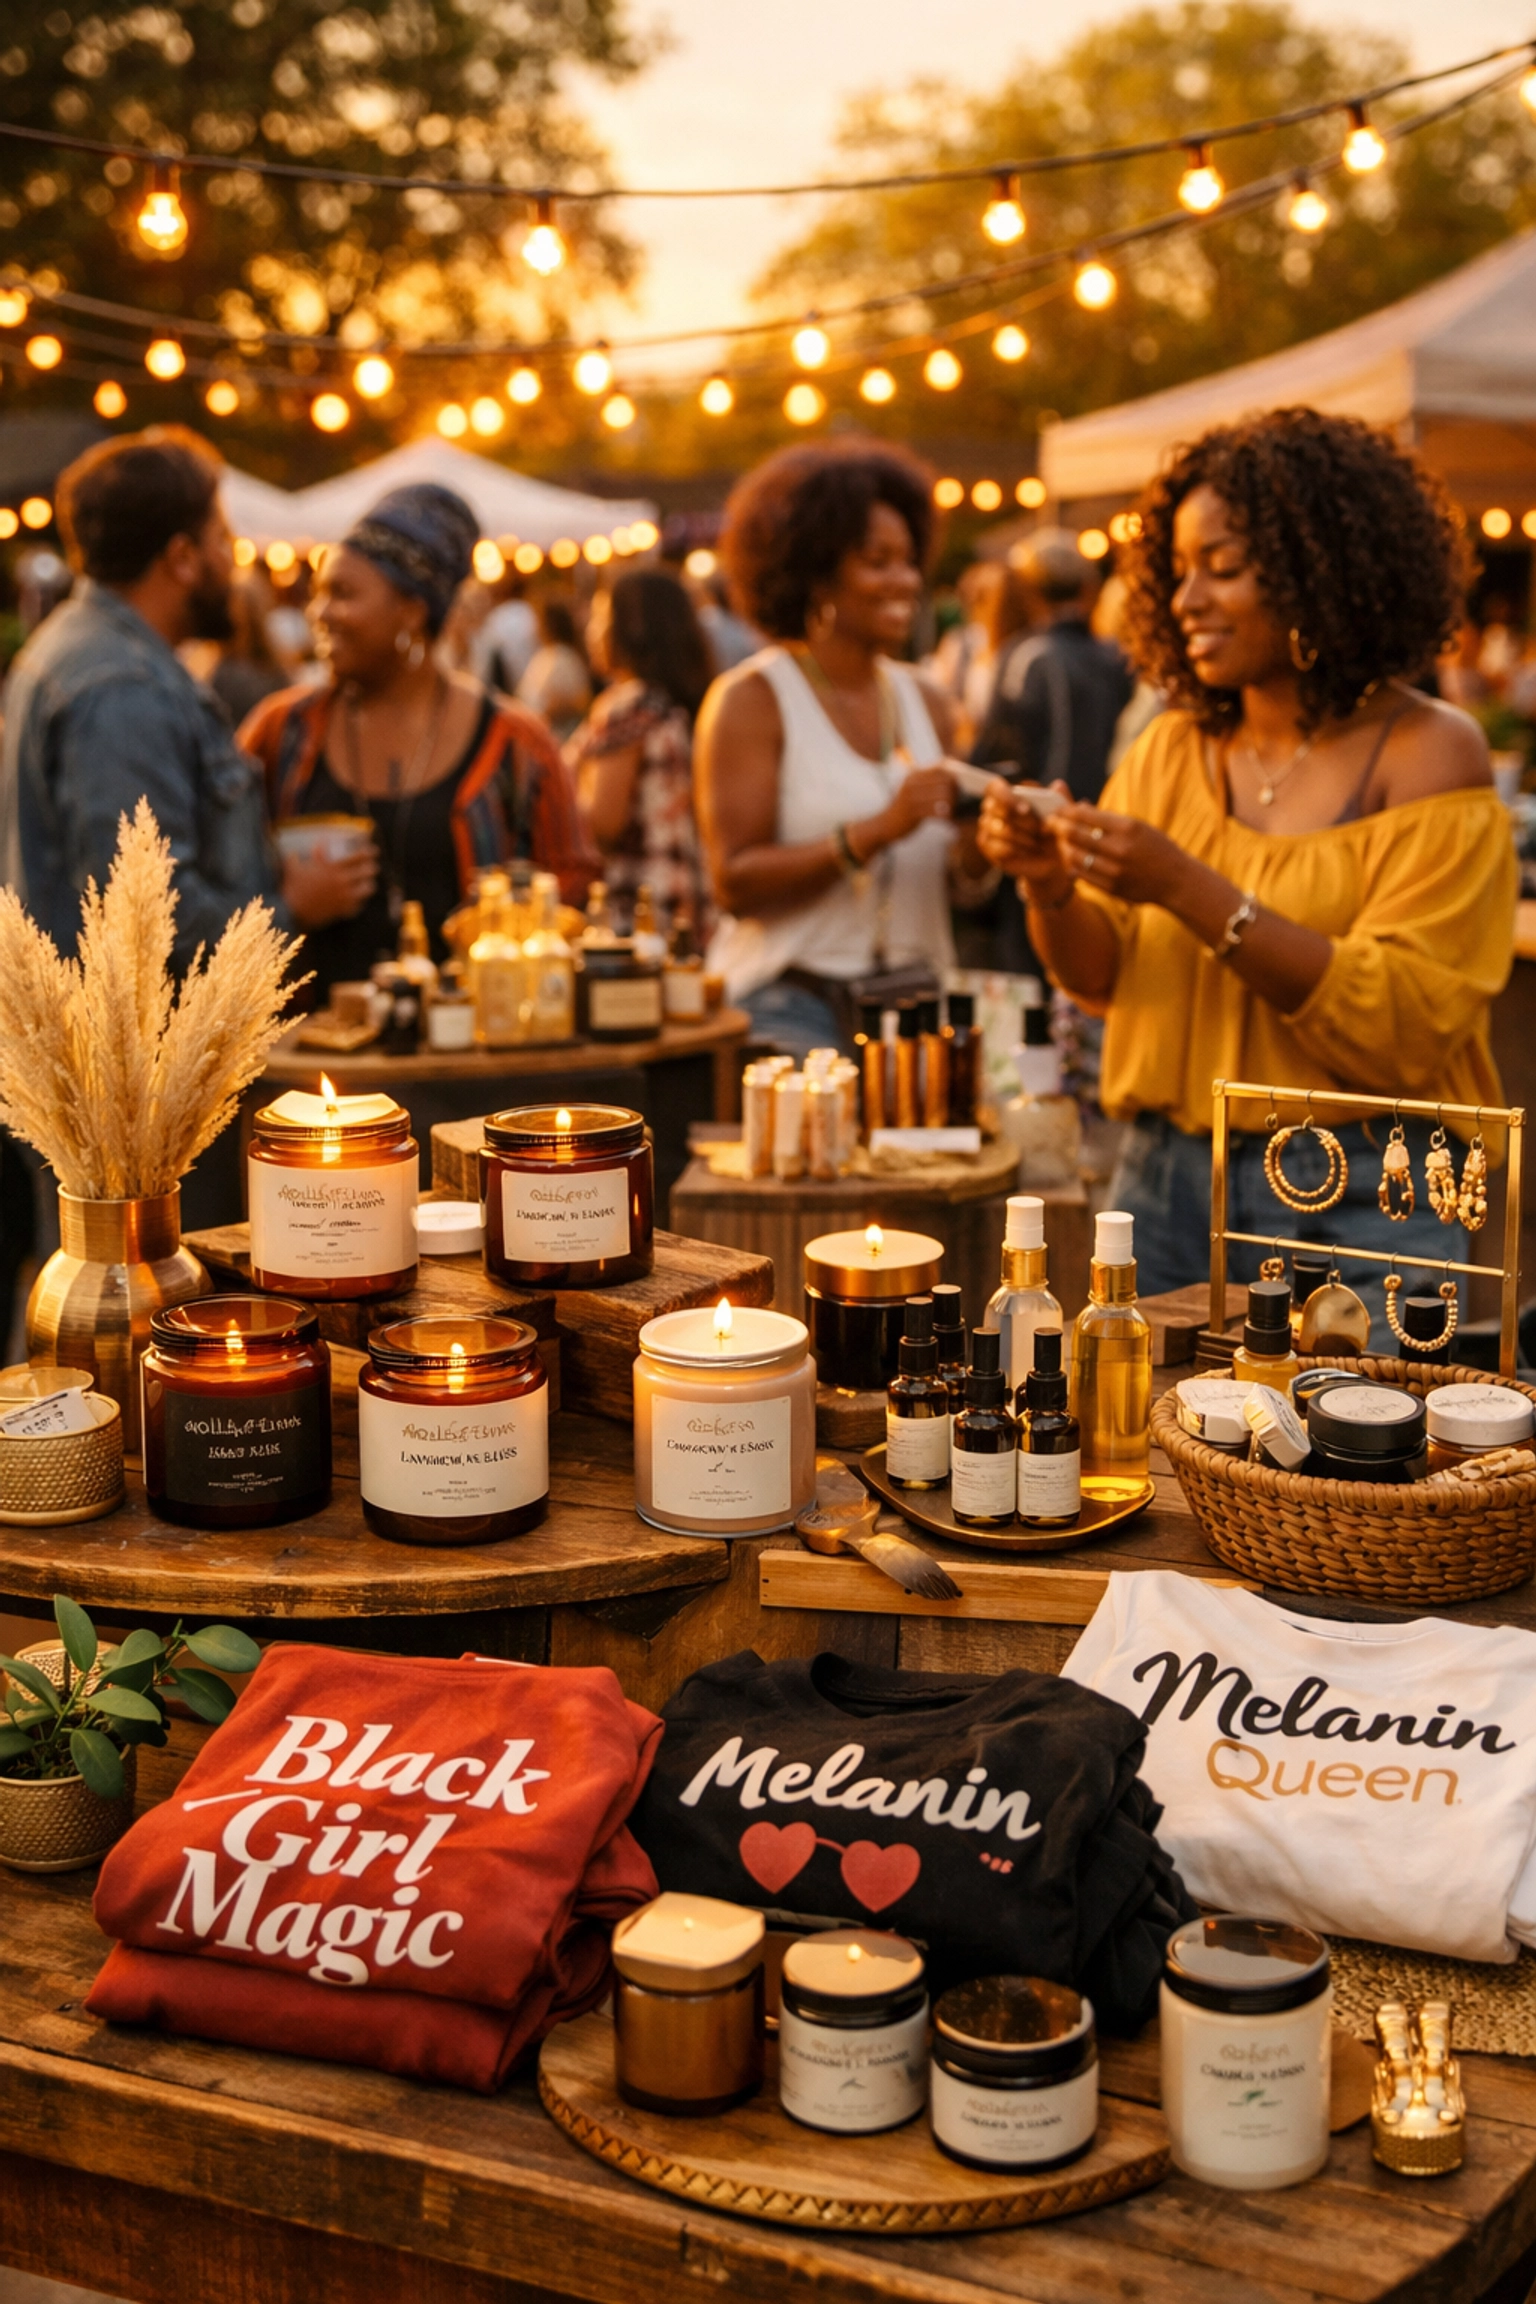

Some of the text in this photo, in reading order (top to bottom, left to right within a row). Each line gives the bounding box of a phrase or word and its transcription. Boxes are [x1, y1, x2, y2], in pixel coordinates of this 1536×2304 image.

[1132, 1651, 1516, 1755] Melanin
[244, 1715, 551, 1815] Black
[679, 1736, 1041, 1841] Melanin
[1206, 1737, 1459, 1806] Queen
[221, 1793, 457, 1884] Girl
[157, 1846, 464, 1987] Magic
